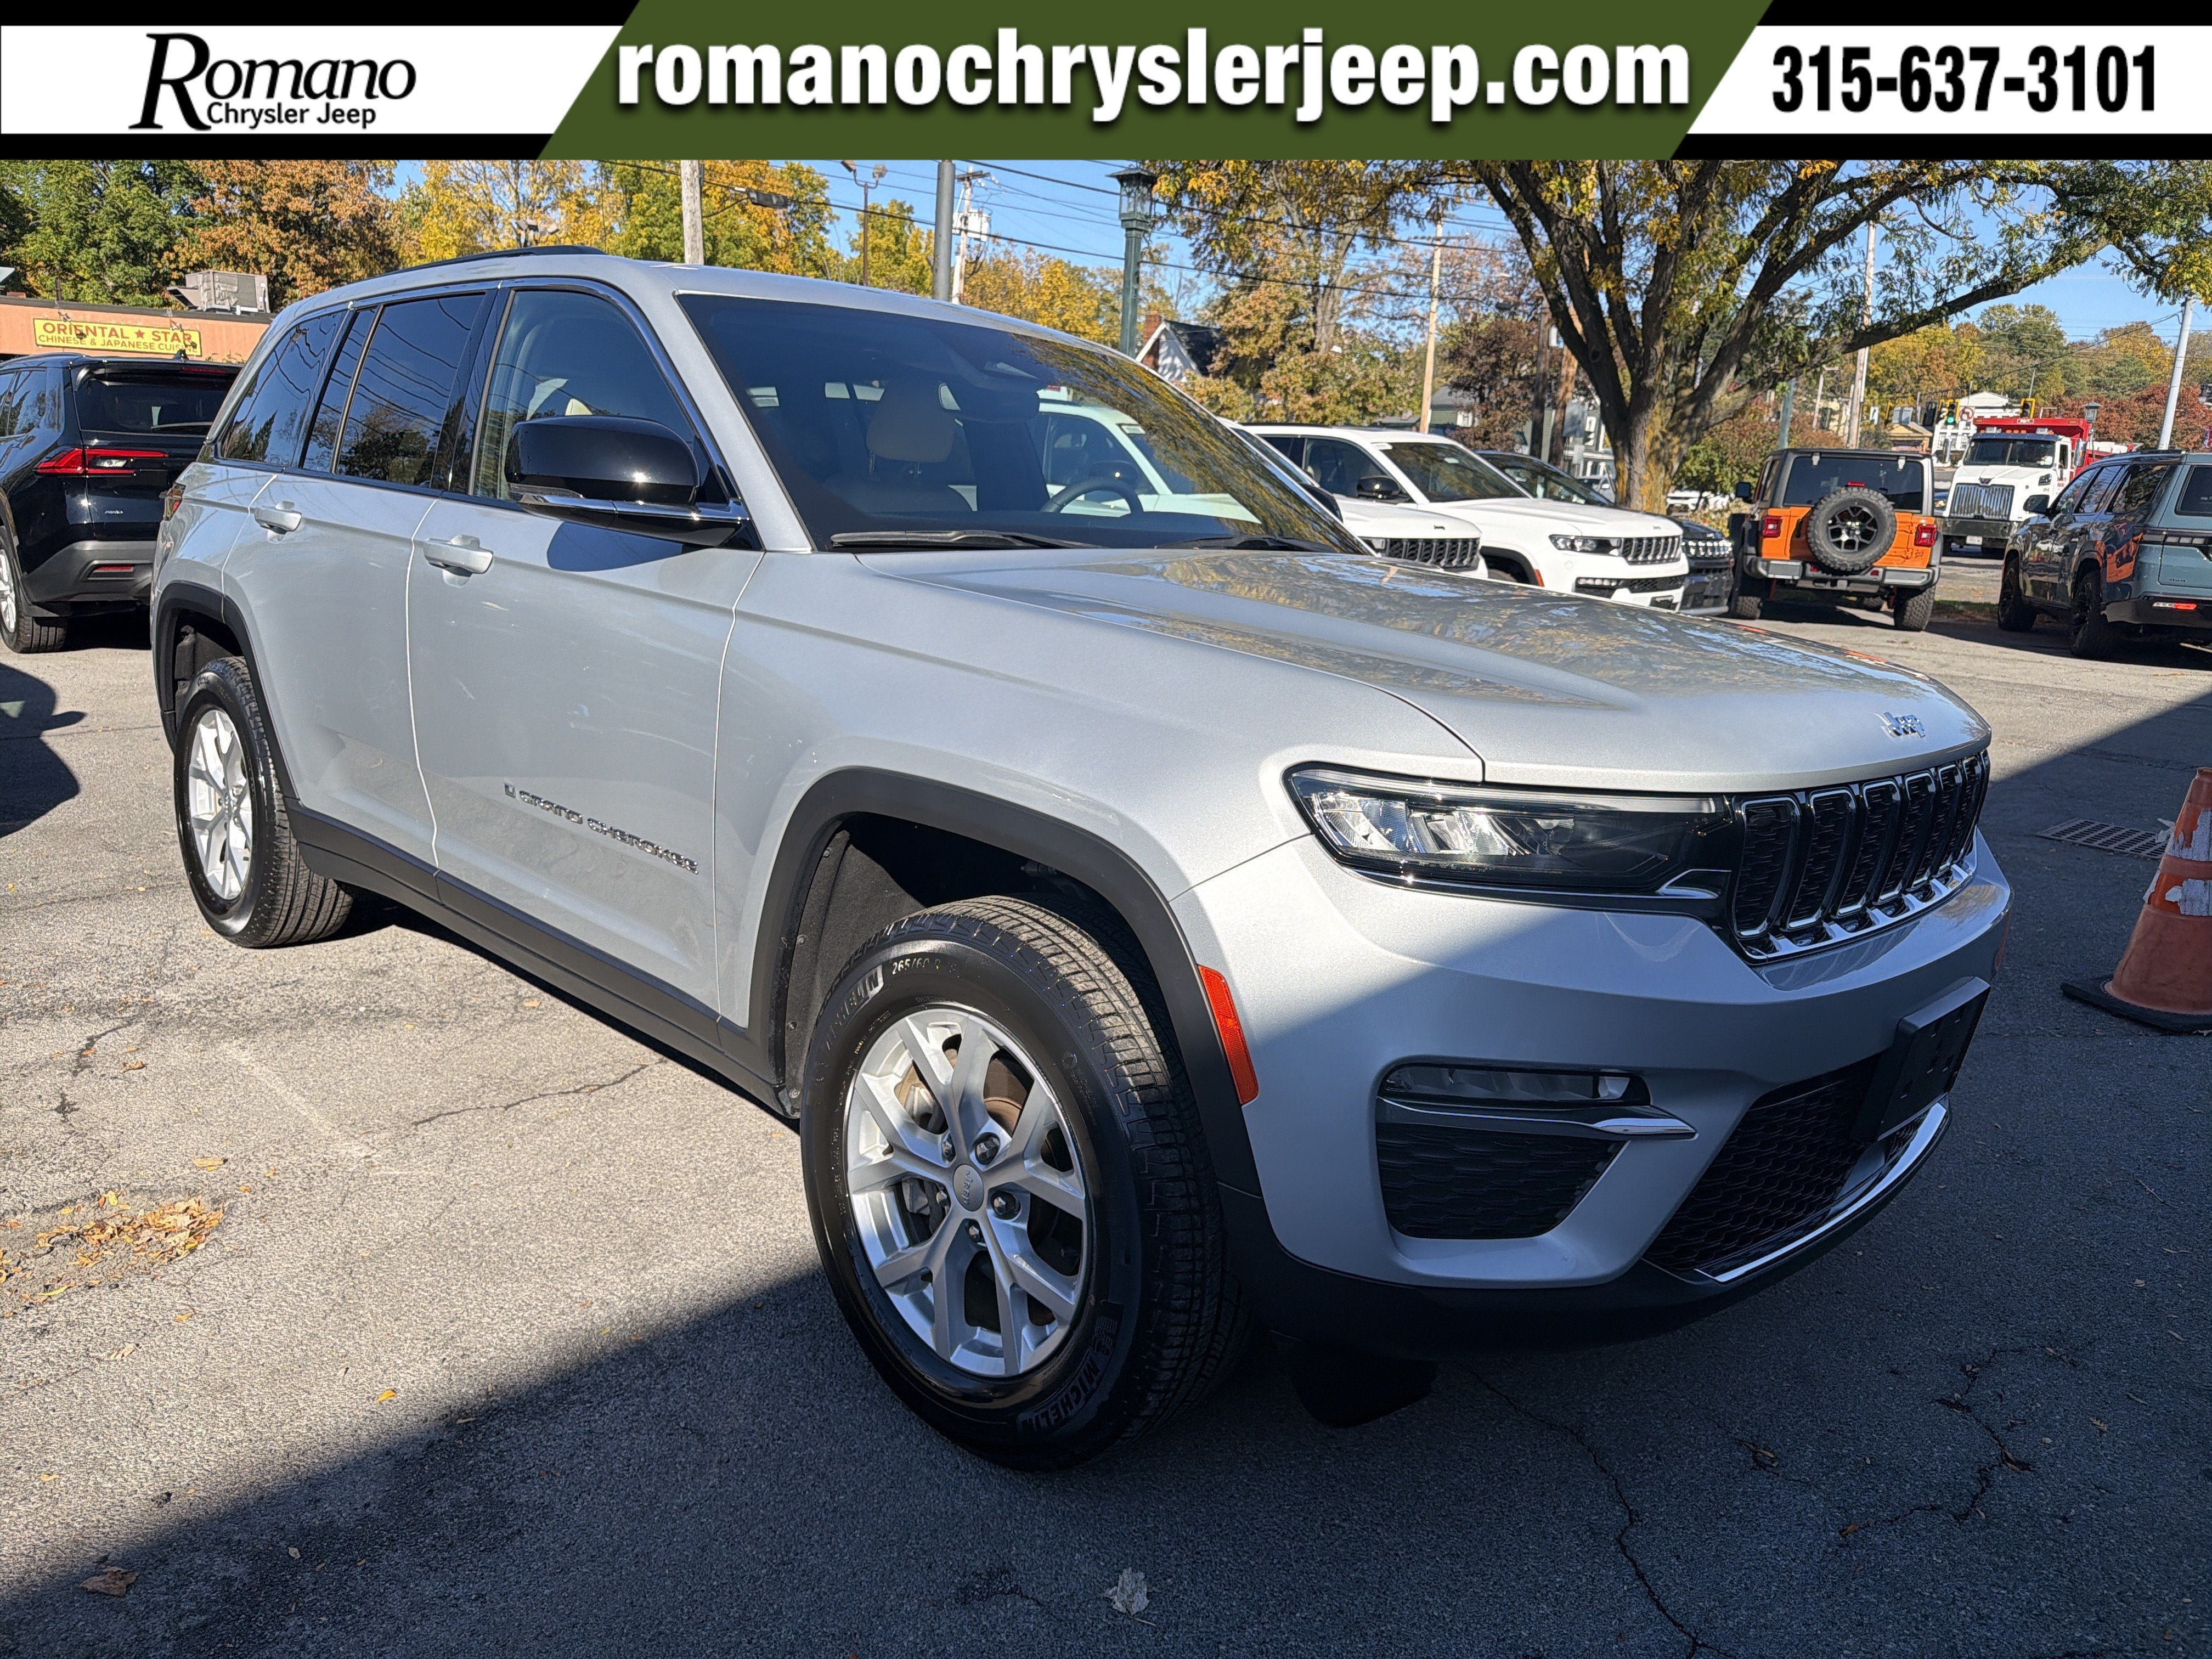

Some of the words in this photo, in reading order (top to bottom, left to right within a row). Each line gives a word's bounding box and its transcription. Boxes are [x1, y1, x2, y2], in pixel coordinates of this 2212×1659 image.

[38, 335, 87, 345] CHINESE
[100, 339, 155, 350] JAPANESE
[43, 323, 129, 340] ORIENTAL
[151, 330, 192, 344] STAR
[1883, 711, 1926, 738] Jeep
